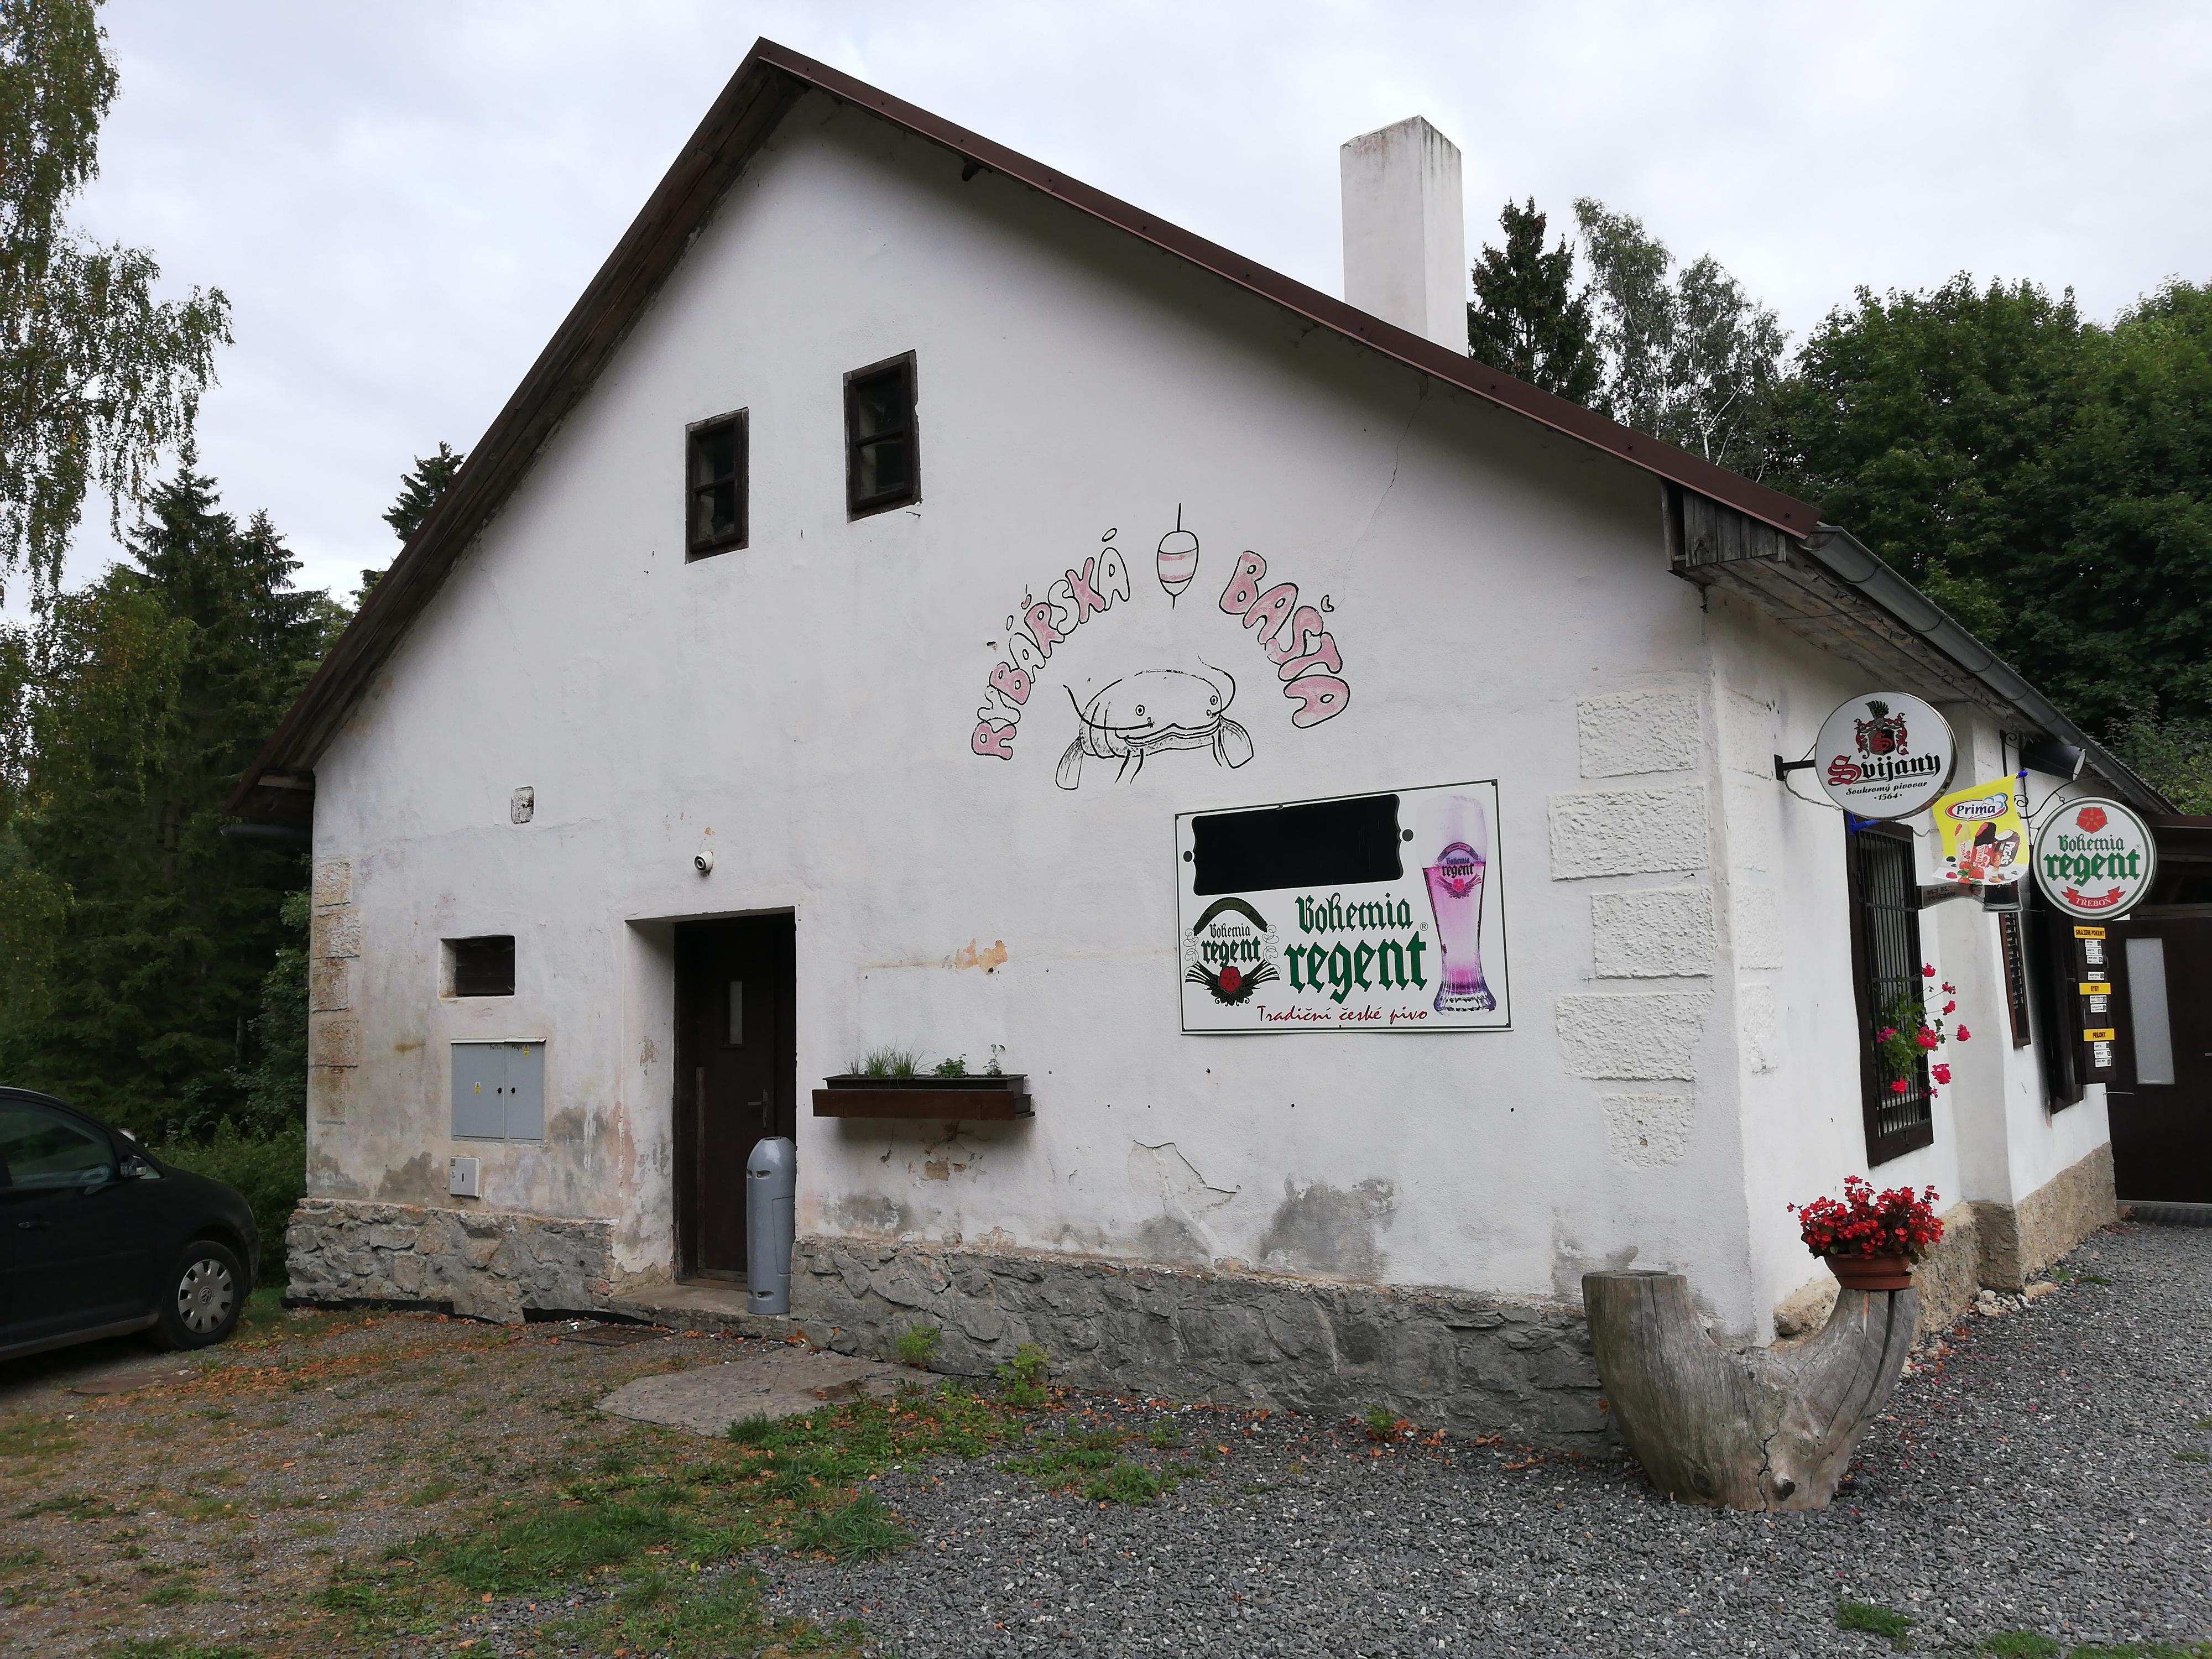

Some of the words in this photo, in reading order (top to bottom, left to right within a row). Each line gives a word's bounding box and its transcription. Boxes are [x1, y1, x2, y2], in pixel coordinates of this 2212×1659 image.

[1828, 753, 1940, 786] Svijany
[1845, 784, 1890, 795] Soukromý
[1893, 781, 1927, 791] pivovar
[1957, 804, 1996, 815] Prima
[2057, 833, 2125, 852] Bohemia
[1442, 862, 1474, 878] regent
[2043, 848, 2140, 887] regent
[2076, 896, 2112, 906] TŘEBOŇ
[1295, 892, 1413, 935] Bohemia
[1209, 923, 1251, 939] Bohemia
[1201, 936, 1261, 968] regent
[1284, 931, 1428, 1004] regent
[1256, 1005, 1332, 1022] Tradiční
[1339, 1005, 1382, 1021] české
[1389, 1005, 1428, 1025] pivo
